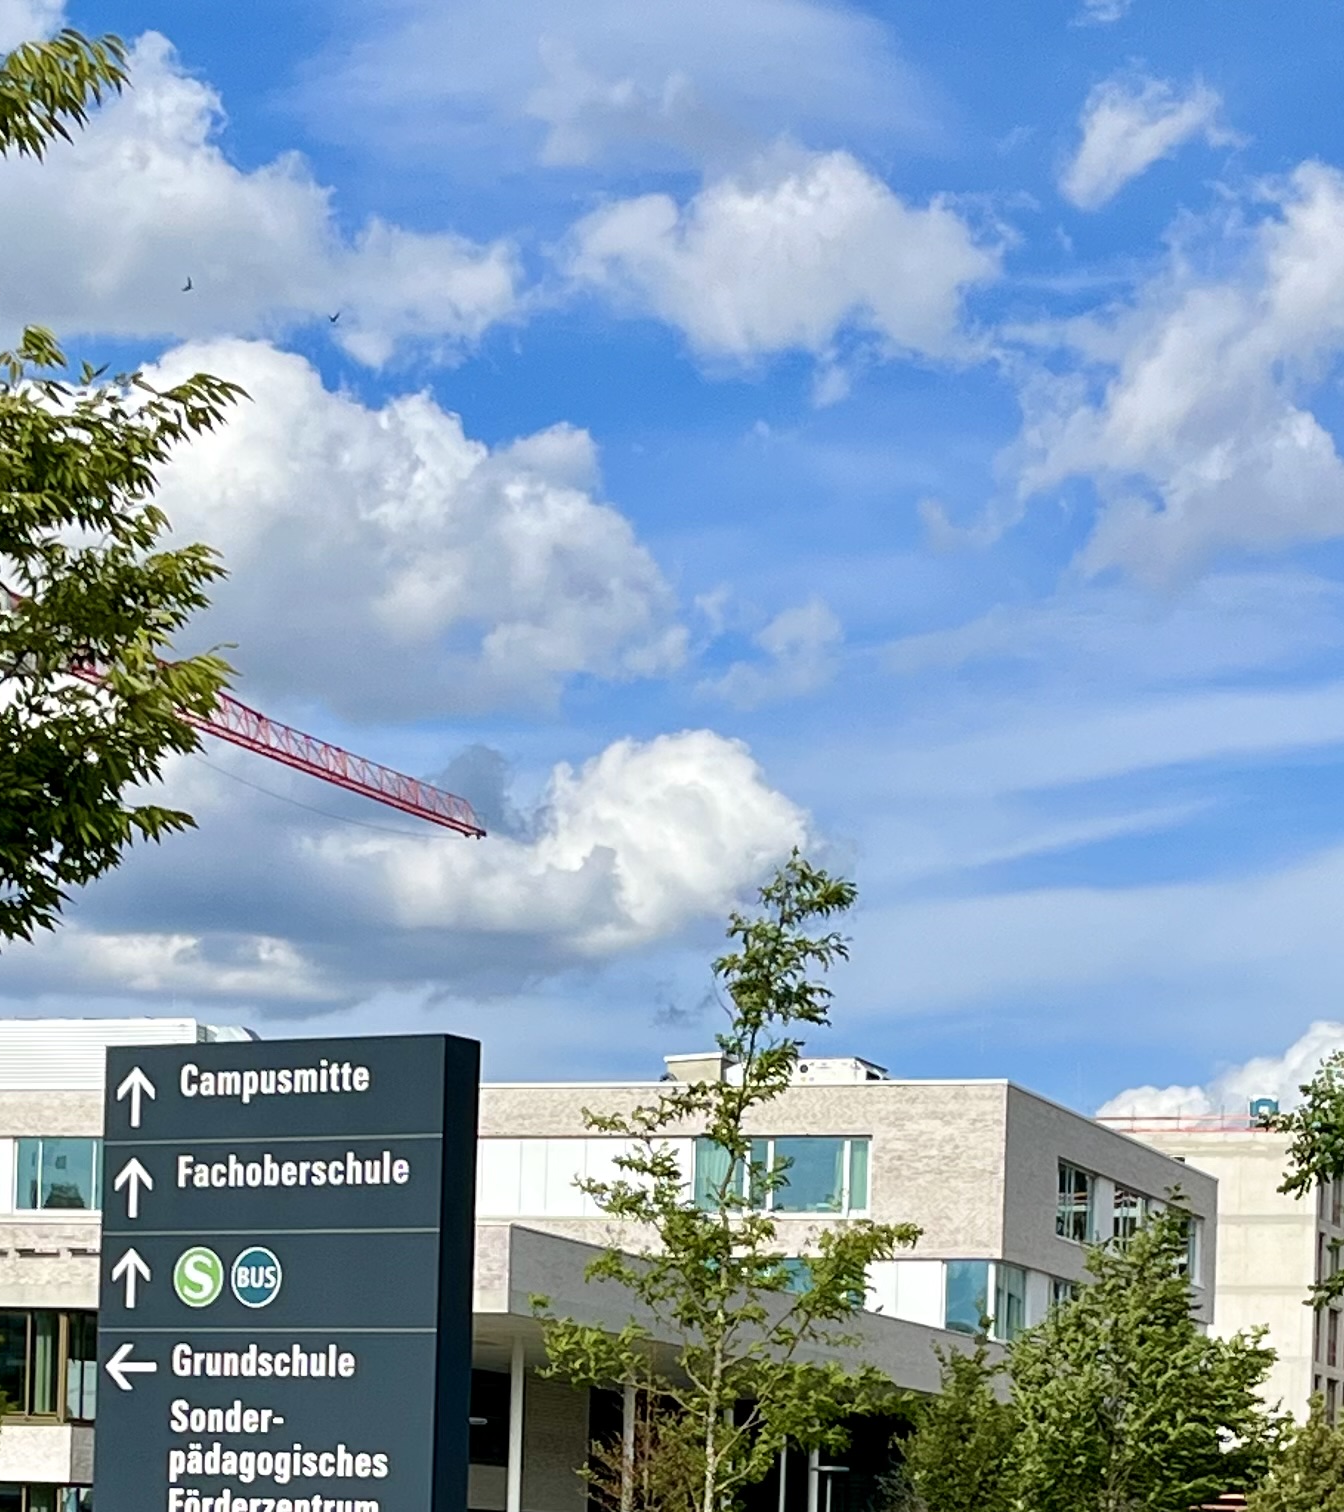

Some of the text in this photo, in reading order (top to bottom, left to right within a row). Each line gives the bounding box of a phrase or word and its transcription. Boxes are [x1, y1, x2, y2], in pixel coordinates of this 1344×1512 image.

[180, 1059, 370, 1104] Campusmitte
[177, 1150, 410, 1188] Fachoberschule
[236, 1266, 277, 1290] BUS
[172, 1343, 355, 1378] Grundschule
[170, 1399, 284, 1433] Sonder-
[168, 1442, 389, 1484] pädagogisches
